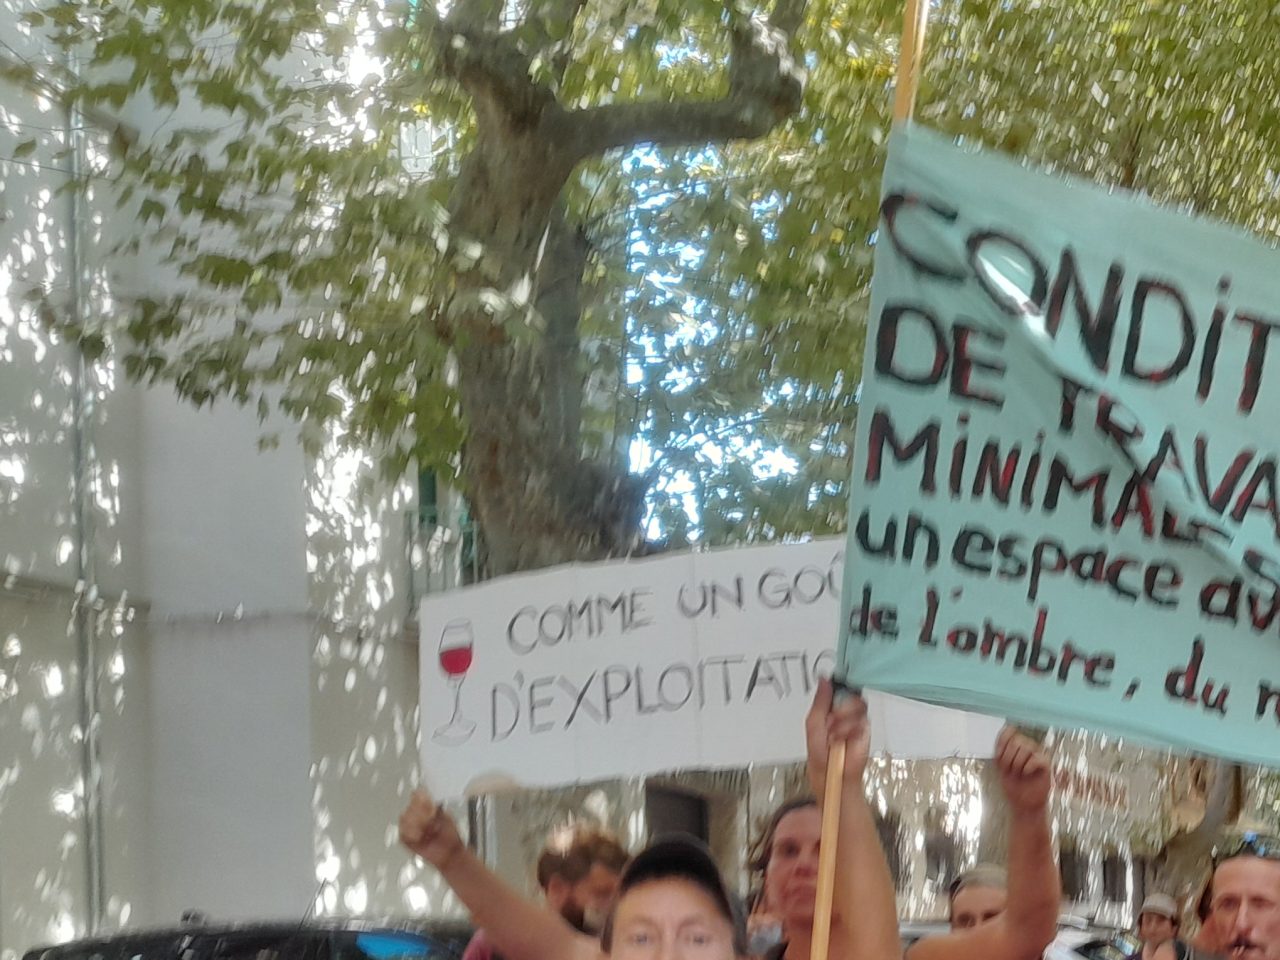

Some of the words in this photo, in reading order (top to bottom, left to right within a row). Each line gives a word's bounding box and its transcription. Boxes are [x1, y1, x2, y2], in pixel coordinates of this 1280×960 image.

[874, 302, 1006, 409] DE
[855, 506, 940, 569] un
[951, 523, 1182, 608] espace
[506, 588, 656, 656] COMME
[677, 576, 747, 619] UN
[850, 583, 898, 638] de
[1165, 635, 1231, 717] du
